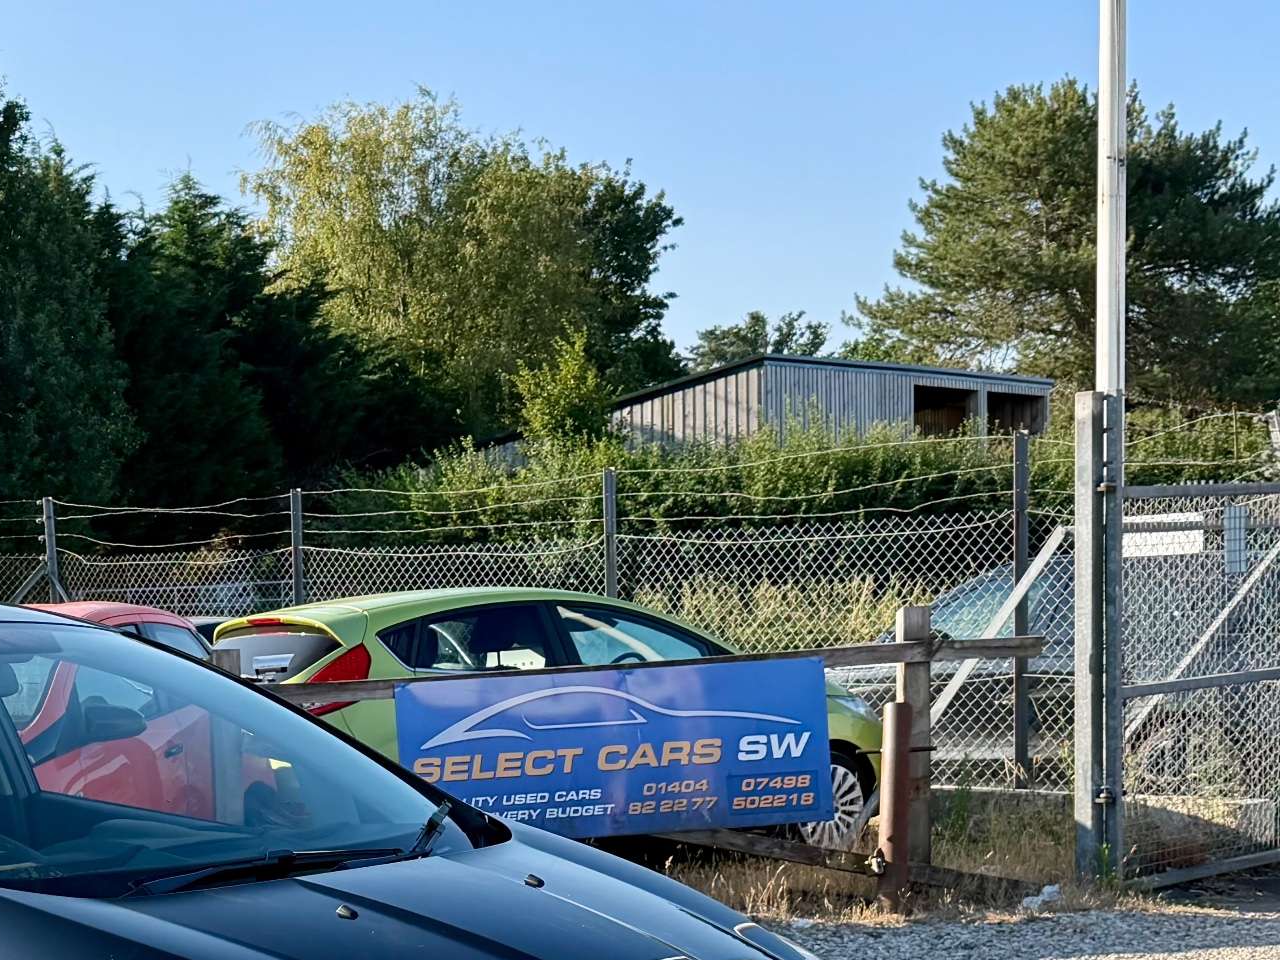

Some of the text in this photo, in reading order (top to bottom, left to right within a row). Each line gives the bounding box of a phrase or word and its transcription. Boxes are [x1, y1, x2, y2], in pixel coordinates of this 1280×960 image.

[413, 731, 812, 784] SELECT CARS SW
[643, 779, 710, 796] 01404
[741, 775, 812, 791] 07498
[502, 792, 549, 806] USED
[554, 788, 602, 802] CARS
[732, 792, 815, 810] 502218
[545, 804, 616, 819] BUDGET
